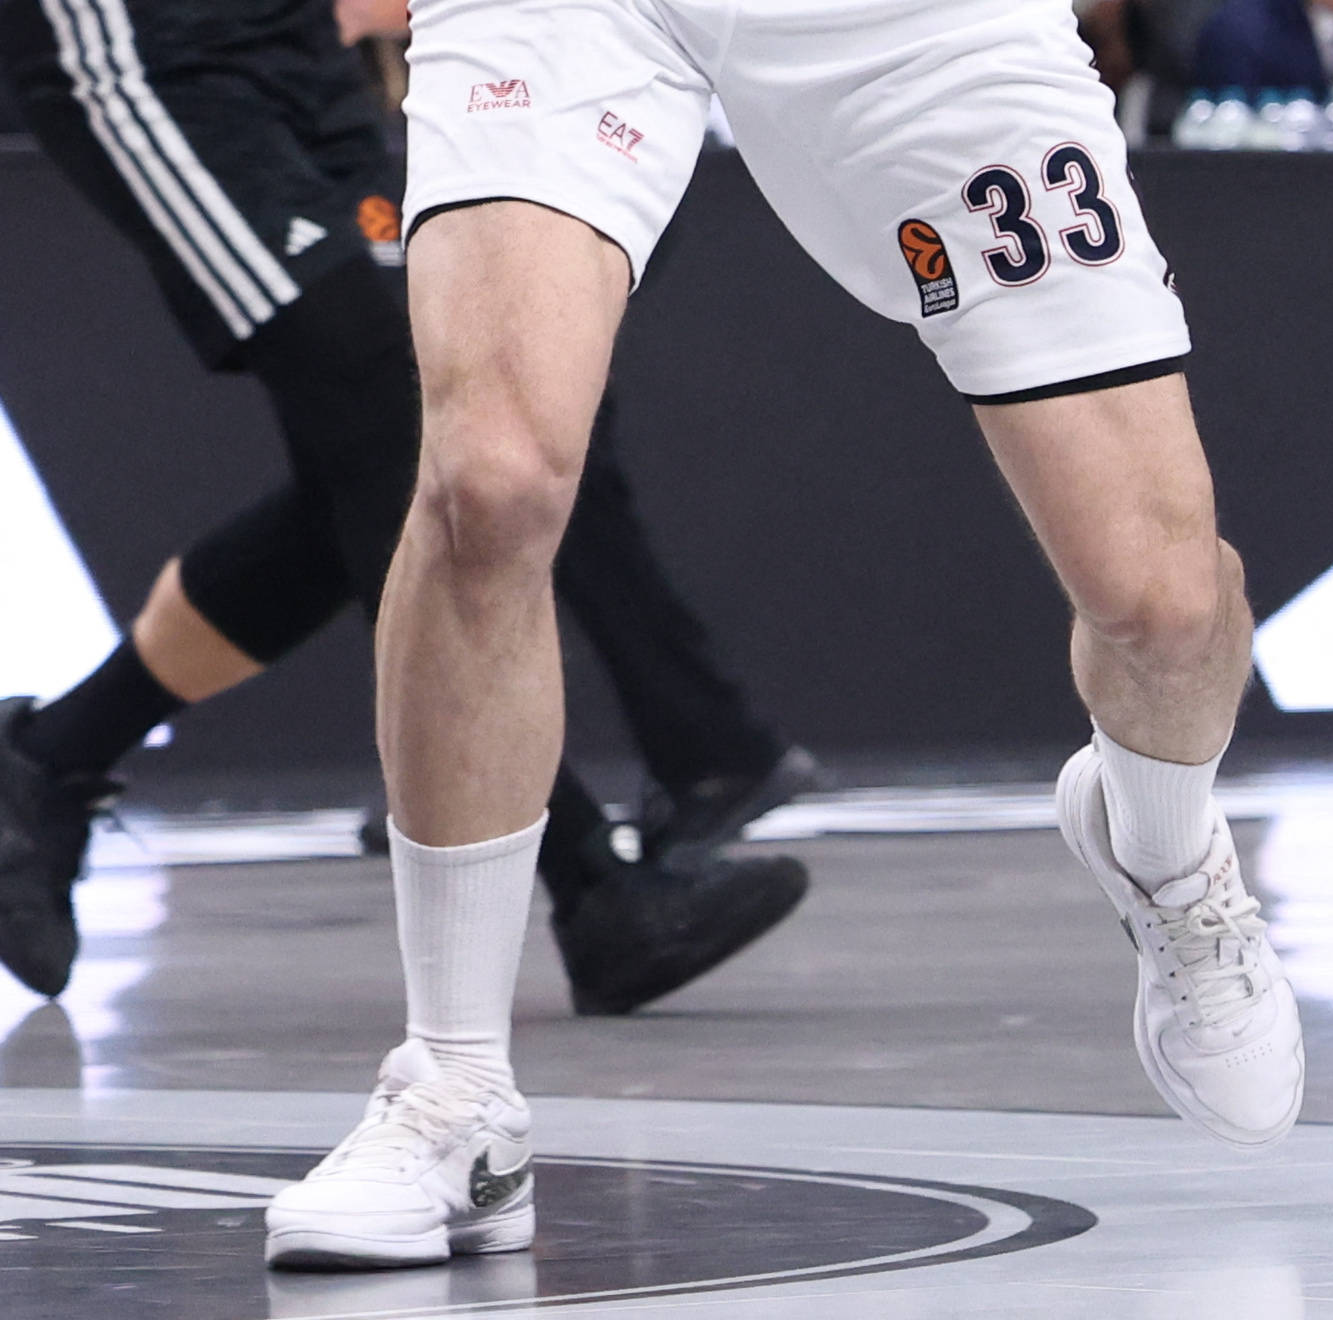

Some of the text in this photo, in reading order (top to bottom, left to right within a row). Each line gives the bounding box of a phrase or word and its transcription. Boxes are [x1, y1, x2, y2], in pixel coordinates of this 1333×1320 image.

[467, 99, 531, 113] EYEWEAR
[598, 110, 645, 152] EA7
[961, 141, 1125, 287] 33
